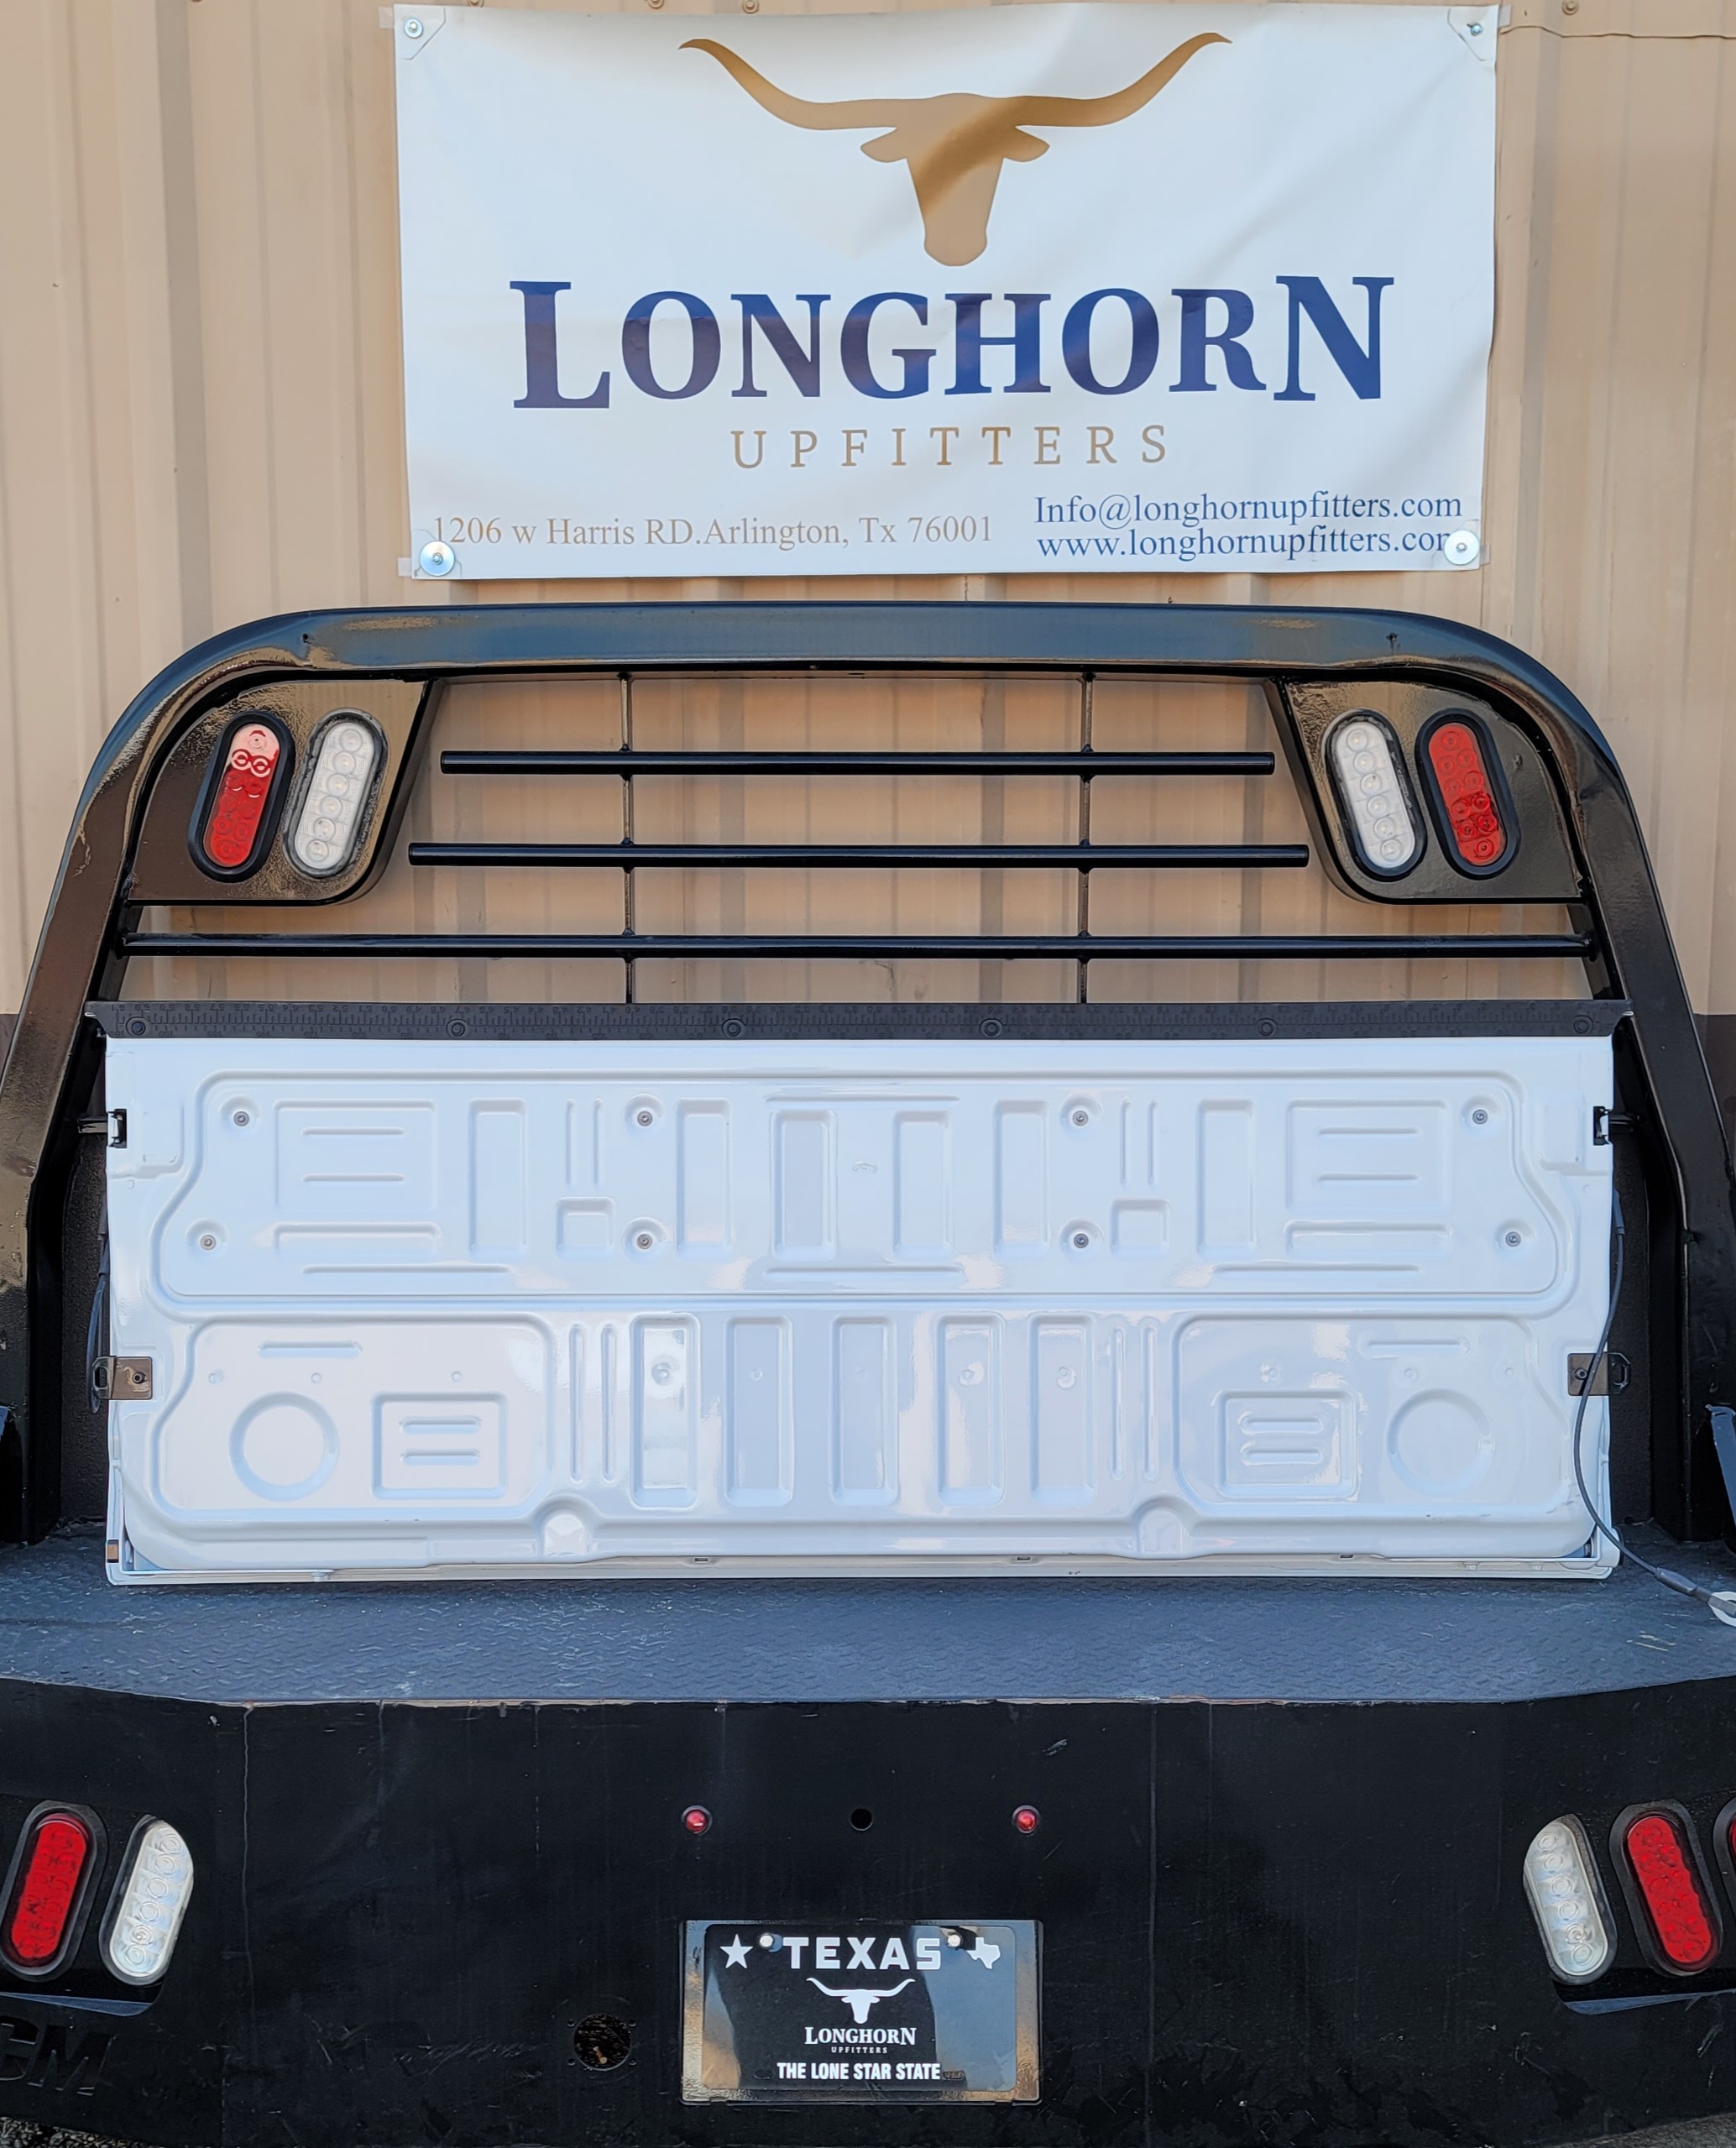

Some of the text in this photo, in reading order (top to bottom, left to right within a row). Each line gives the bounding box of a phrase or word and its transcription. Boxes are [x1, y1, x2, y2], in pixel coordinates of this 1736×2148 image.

[509, 274, 1394, 410] LONGHORN
[729, 425, 1166, 468] UPFITTERS
[1033, 490, 1463, 530] Info@longhornupfitters.com
[433, 517, 502, 544] 1206
[510, 525, 538, 544] w
[546, 518, 635, 545] Harris
[858, 517, 898, 543] Tx
[907, 516, 992, 543] 76001
[782, 1936, 941, 1970] TEXAS
[804, 2026, 917, 2046] LONGHORN
[830, 2046, 887, 2054] UPFITTERS
[776, 2062, 941, 2080] THE LONE STAR STATE
